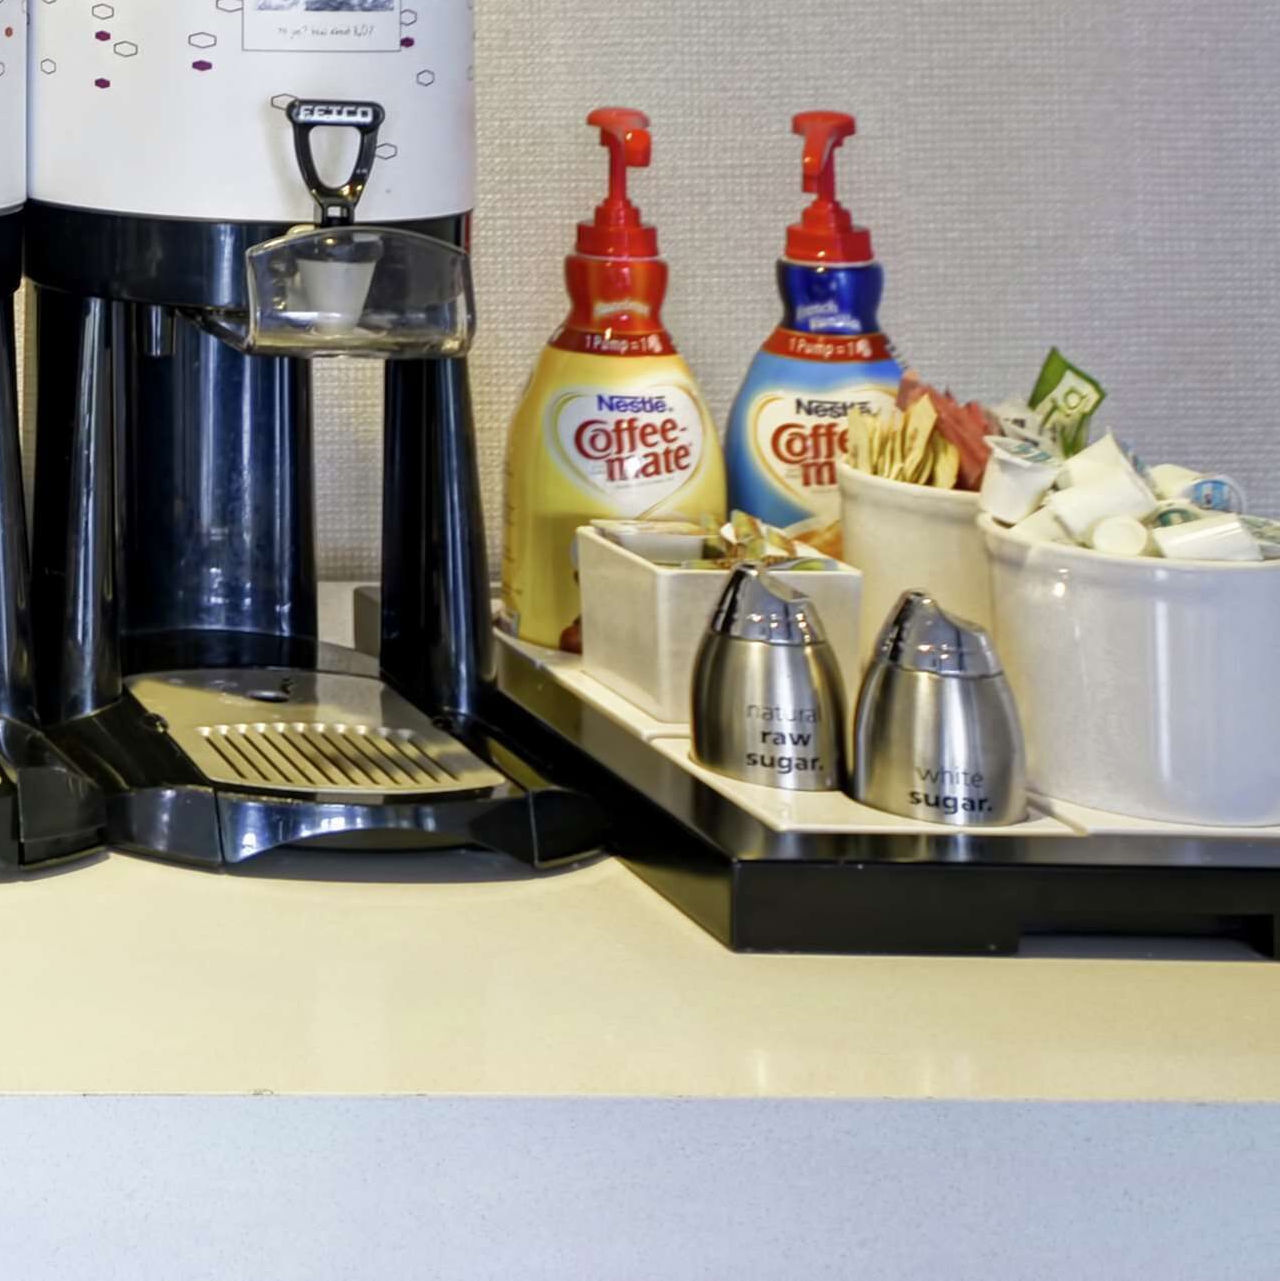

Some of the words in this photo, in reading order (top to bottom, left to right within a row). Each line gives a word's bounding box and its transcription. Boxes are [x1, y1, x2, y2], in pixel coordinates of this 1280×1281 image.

[299, 105, 373, 123] FETCO
[606, 443, 691, 483] mate
[760, 730, 812, 747] raw
[745, 751, 825, 775] sugar.
[915, 765, 985, 789] white
[908, 790, 994, 816] sugar.
